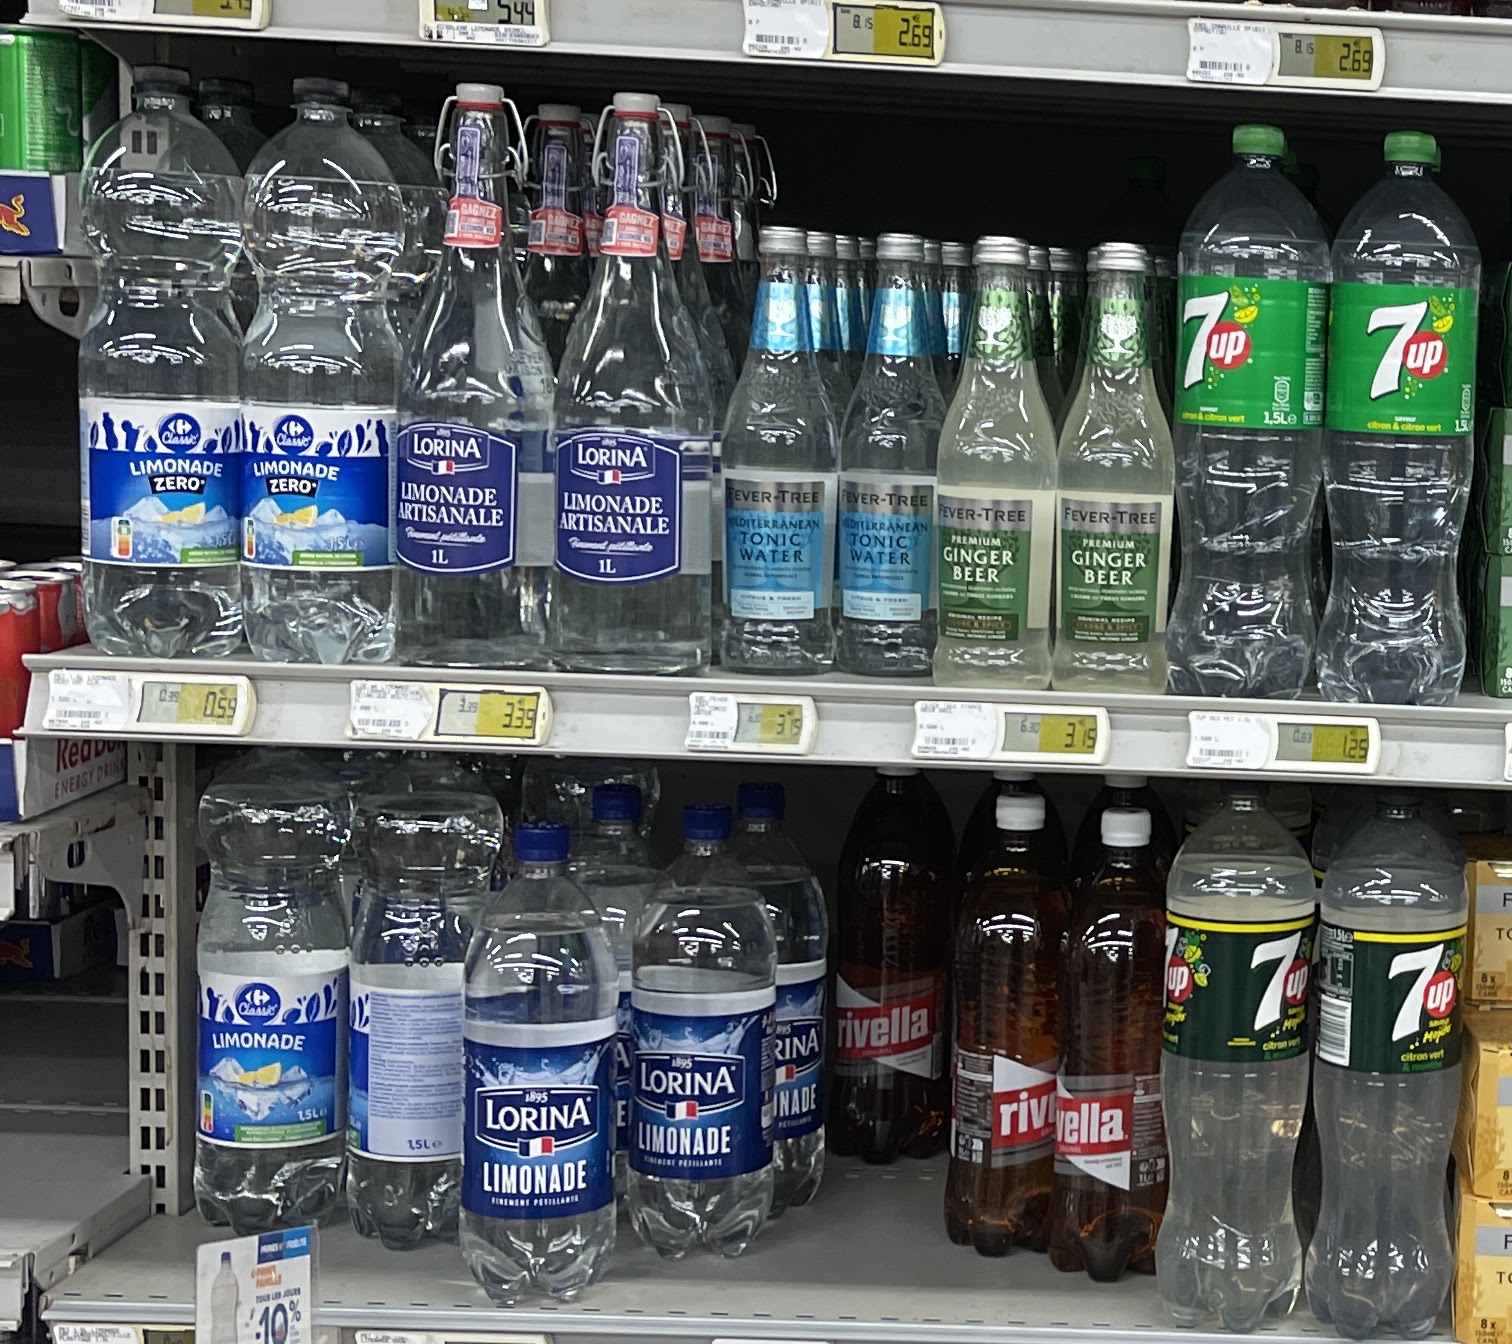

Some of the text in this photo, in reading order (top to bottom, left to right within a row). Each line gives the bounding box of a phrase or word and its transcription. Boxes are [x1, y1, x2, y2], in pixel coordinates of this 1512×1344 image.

[414, 434, 482, 458] LORINA
[578, 443, 647, 468] LORINA
[130, 462, 224, 478] LIMONADE
[253, 462, 340, 480] LIMONADE
[401, 484, 497, 506] LIMONADE
[564, 495, 662, 515] LIMONADE
[398, 505, 504, 527] ARTISANALE
[559, 513, 669, 534] ARTISANALE
[1064, 507, 1156, 526] FEVER-TREE
[739, 532, 801, 548] TONIC
[1082, 538, 1135, 550] PREMIUM
[431, 549, 449, 564] 1L
[739, 548, 805, 564] WATER
[1072, 550, 1146, 568] GINGER
[1084, 567, 1133, 586] BEER
[54, 768, 94, 799] ENERGY
[838, 1007, 930, 1049] rivella
[212, 1031, 306, 1051] LIMONADE
[639, 1066, 735, 1095] LORINA
[485, 1096, 591, 1130] LORINA
[637, 1124, 731, 1153] LIMONADE
[483, 1161, 587, 1195] LIMONADE
